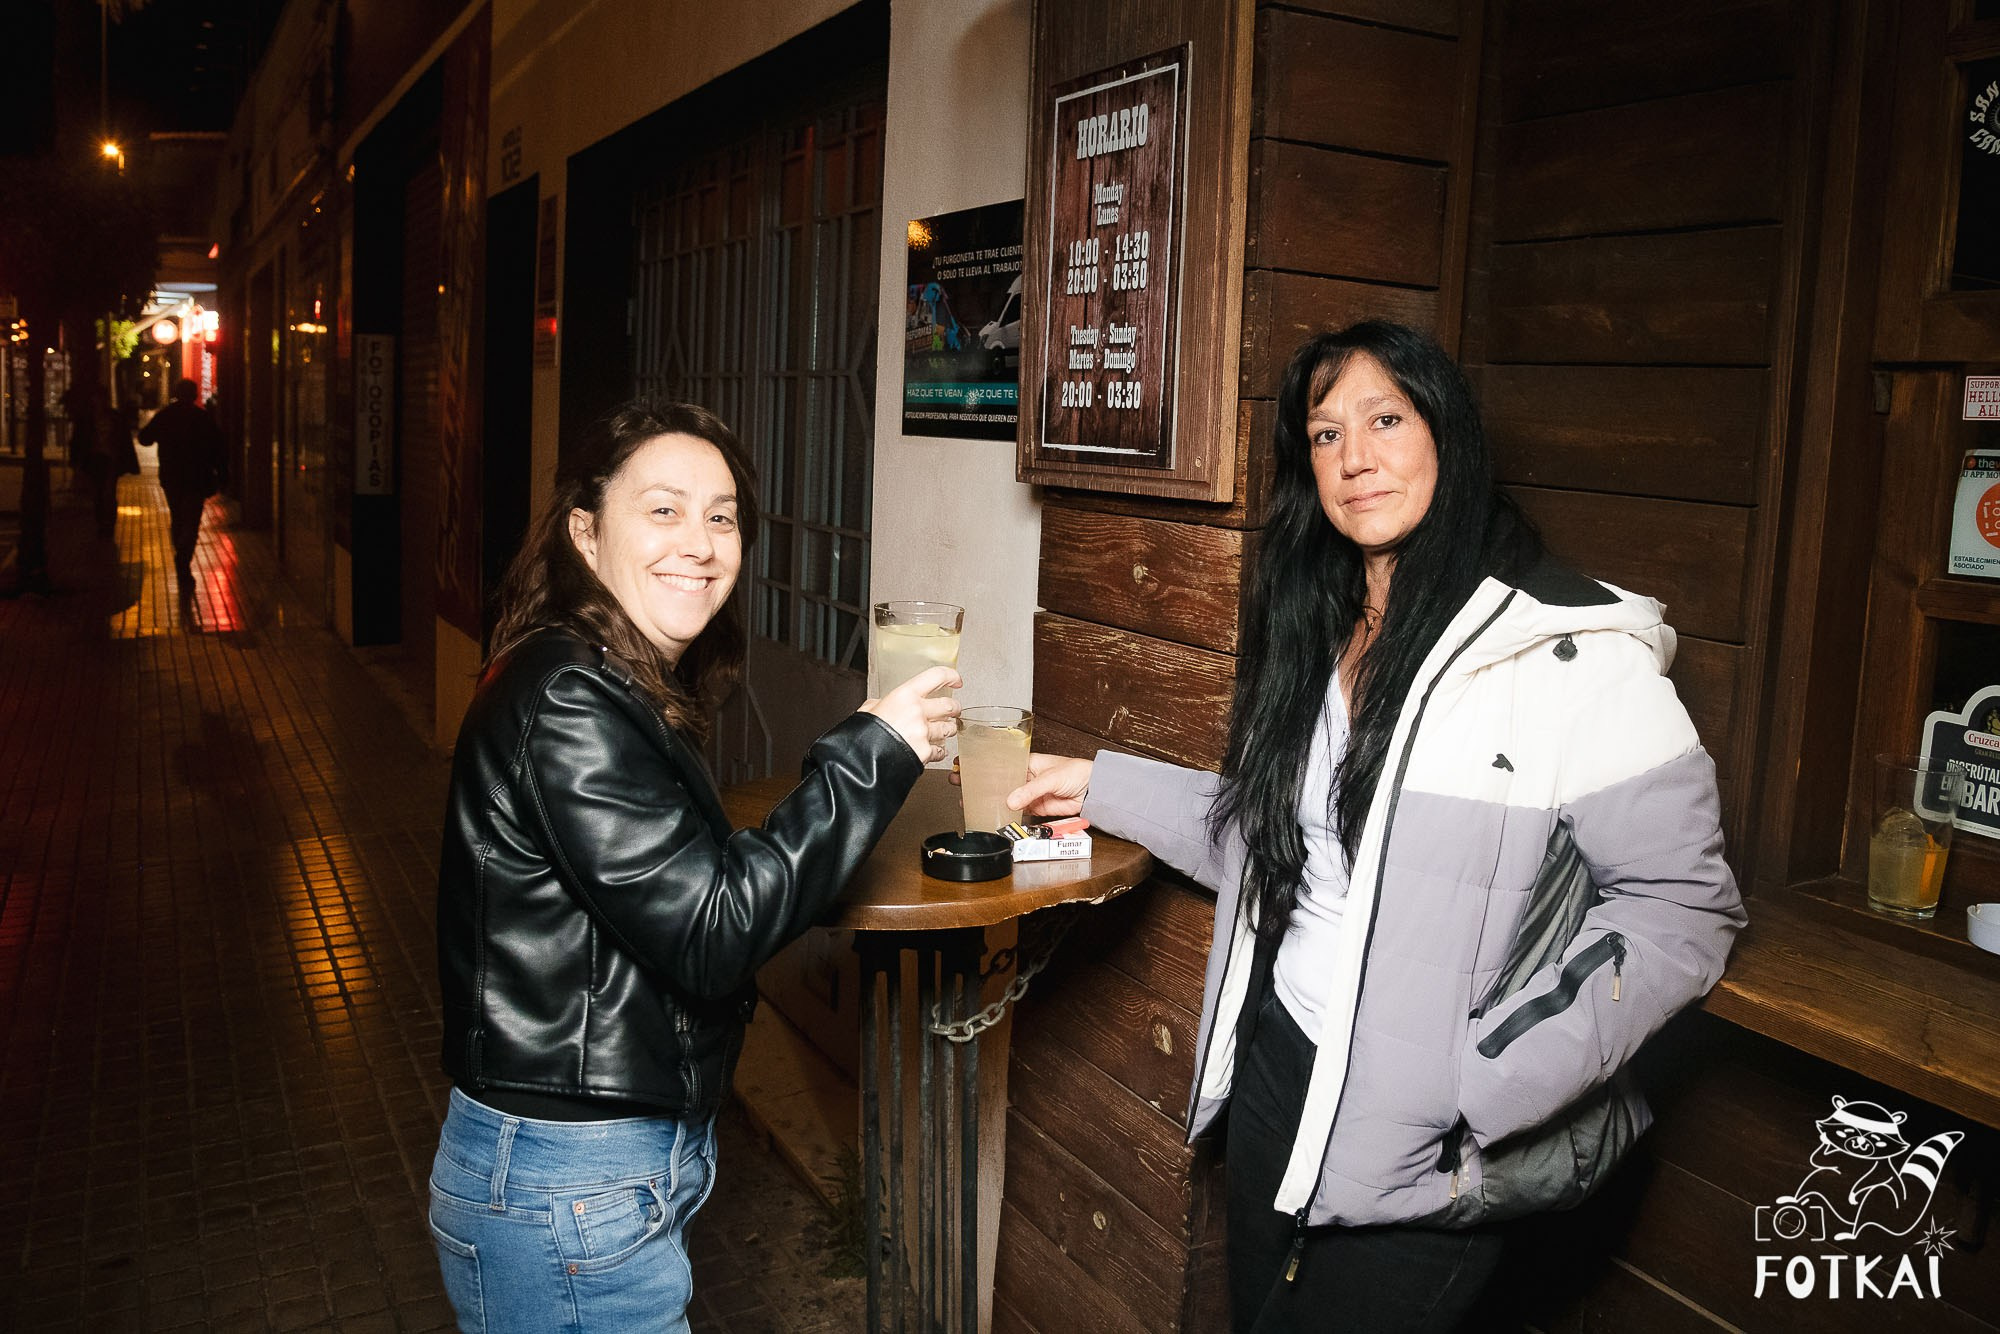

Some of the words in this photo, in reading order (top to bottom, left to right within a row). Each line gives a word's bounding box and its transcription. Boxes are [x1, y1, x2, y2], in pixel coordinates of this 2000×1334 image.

[1077, 103, 1149, 160] HORARIO
[1094, 180, 1124, 206] Monday
[1096, 205, 1120, 226] Lunes
[942, 251, 975, 265] FURGONETA
[976, 250, 983, 260] TE
[984, 248, 999, 259] TRAE
[1068, 237, 1100, 267] 10:00
[1115, 230, 1149, 262] 14:30
[943, 269, 957, 280] SOLO
[958, 268, 965, 277] TE
[965, 265, 982, 277] LLEVA
[983, 264, 991, 274] AL
[1066, 265, 1098, 295] 20:00
[1113, 260, 1148, 291] 03:30
[1070, 324, 1099, 350] Tuesday
[1109, 321, 1137, 348] Sunday
[1069, 349, 1094, 370] Martes
[1103, 347, 1136, 374] Domingo
[907, 388, 920, 397] HAZ
[920, 388, 934, 399] QUE
[934, 388, 943, 397] TE
[943, 388, 963, 398] VEAN
[985, 389, 1002, 399] QUE
[1003, 389, 1014, 398] TE
[1061, 380, 1093, 408] 20:00
[1107, 380, 1141, 409] 03:30
[1969, 390, 2000, 403] HELL
[368, 341, 382, 487] FOTOCOPIAS
[949, 412, 959, 420] PARA
[959, 413, 979, 421] NEGOCIOS
[979, 413, 988, 422] QUE
[988, 414, 1007, 422] QUIEREN
[1978, 404, 2000, 417] ALI
[1970, 471, 1985, 479] APP
[1986, 471, 2000, 479] MO
[1953, 562, 1985, 571] ASOCIADO
[1961, 781, 2000, 816] BAR
